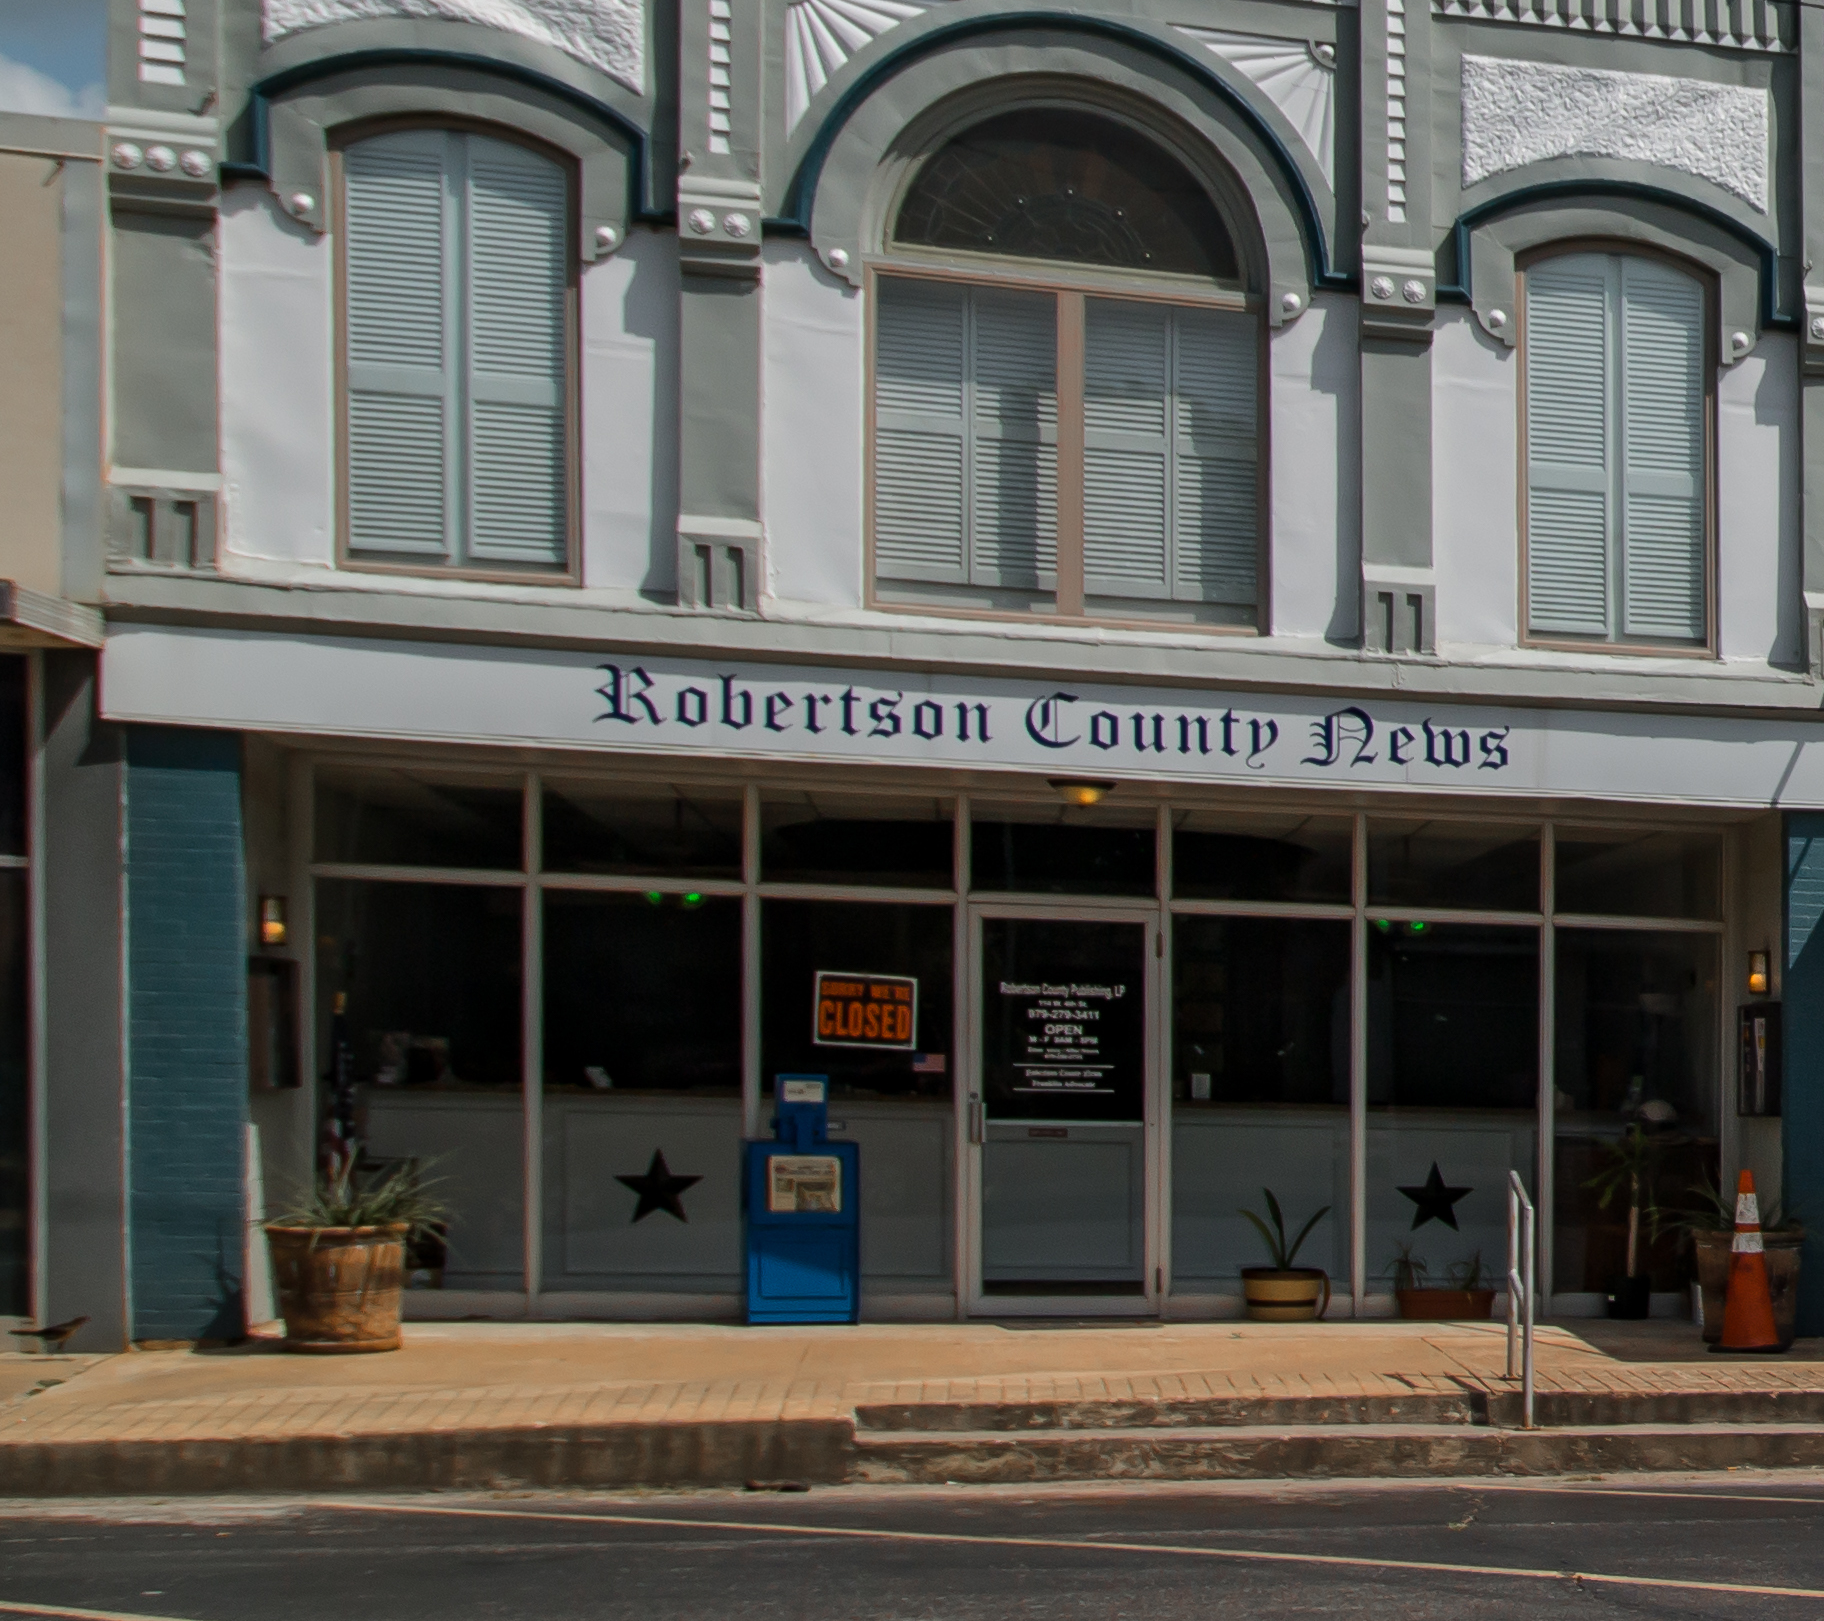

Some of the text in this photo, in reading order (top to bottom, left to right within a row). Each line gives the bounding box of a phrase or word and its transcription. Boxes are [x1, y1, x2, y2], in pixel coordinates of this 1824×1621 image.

[593, 663, 1511, 770] Robertson County News
[818, 999, 911, 1039] CLOSED
[1044, 1024, 1083, 1035] OPEN
